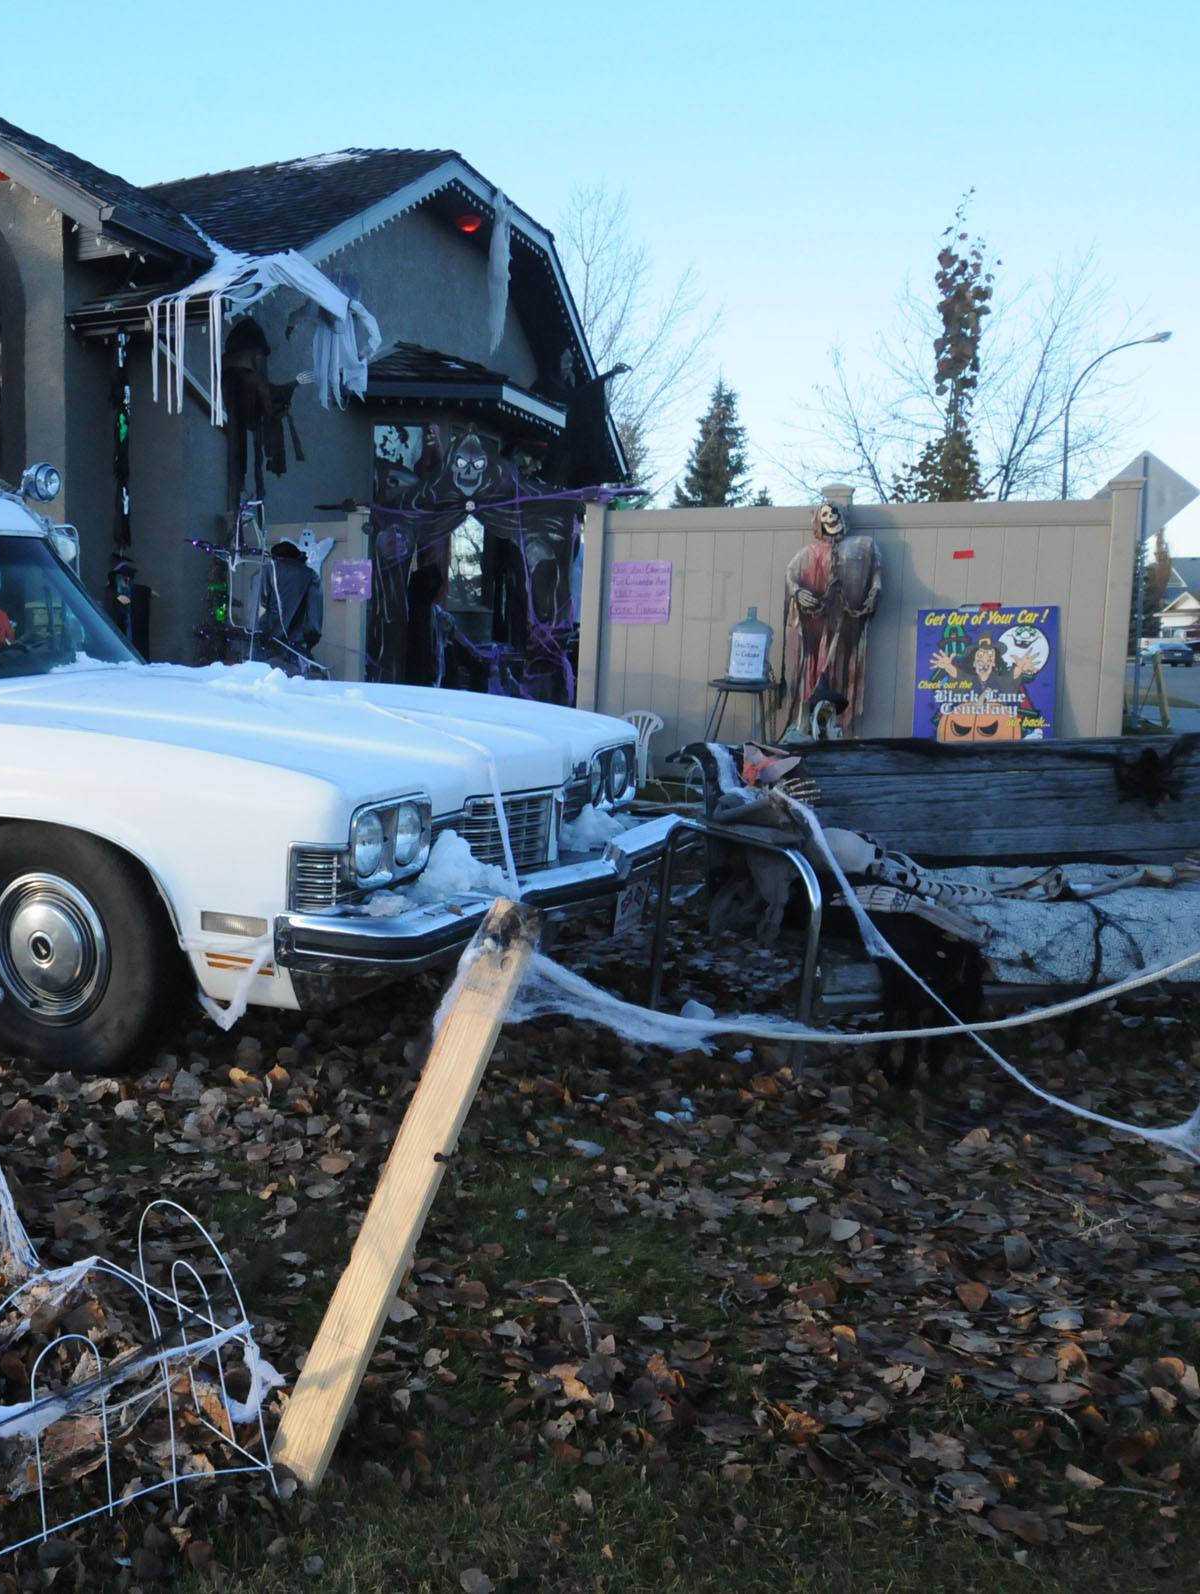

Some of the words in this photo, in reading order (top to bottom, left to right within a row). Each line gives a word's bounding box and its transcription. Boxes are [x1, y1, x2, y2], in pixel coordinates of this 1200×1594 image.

[924, 612, 946, 626] Get
[947, 611, 969, 625] Out
[971, 611, 987, 623] of
[986, 609, 1015, 624] Your
[1017, 609, 1039, 624] Car
[918, 680, 941, 689] Check
[943, 681, 958, 689] out
[959, 680, 973, 689] the
[934, 689, 979, 703] Black
[985, 689, 1026, 703] Lane
